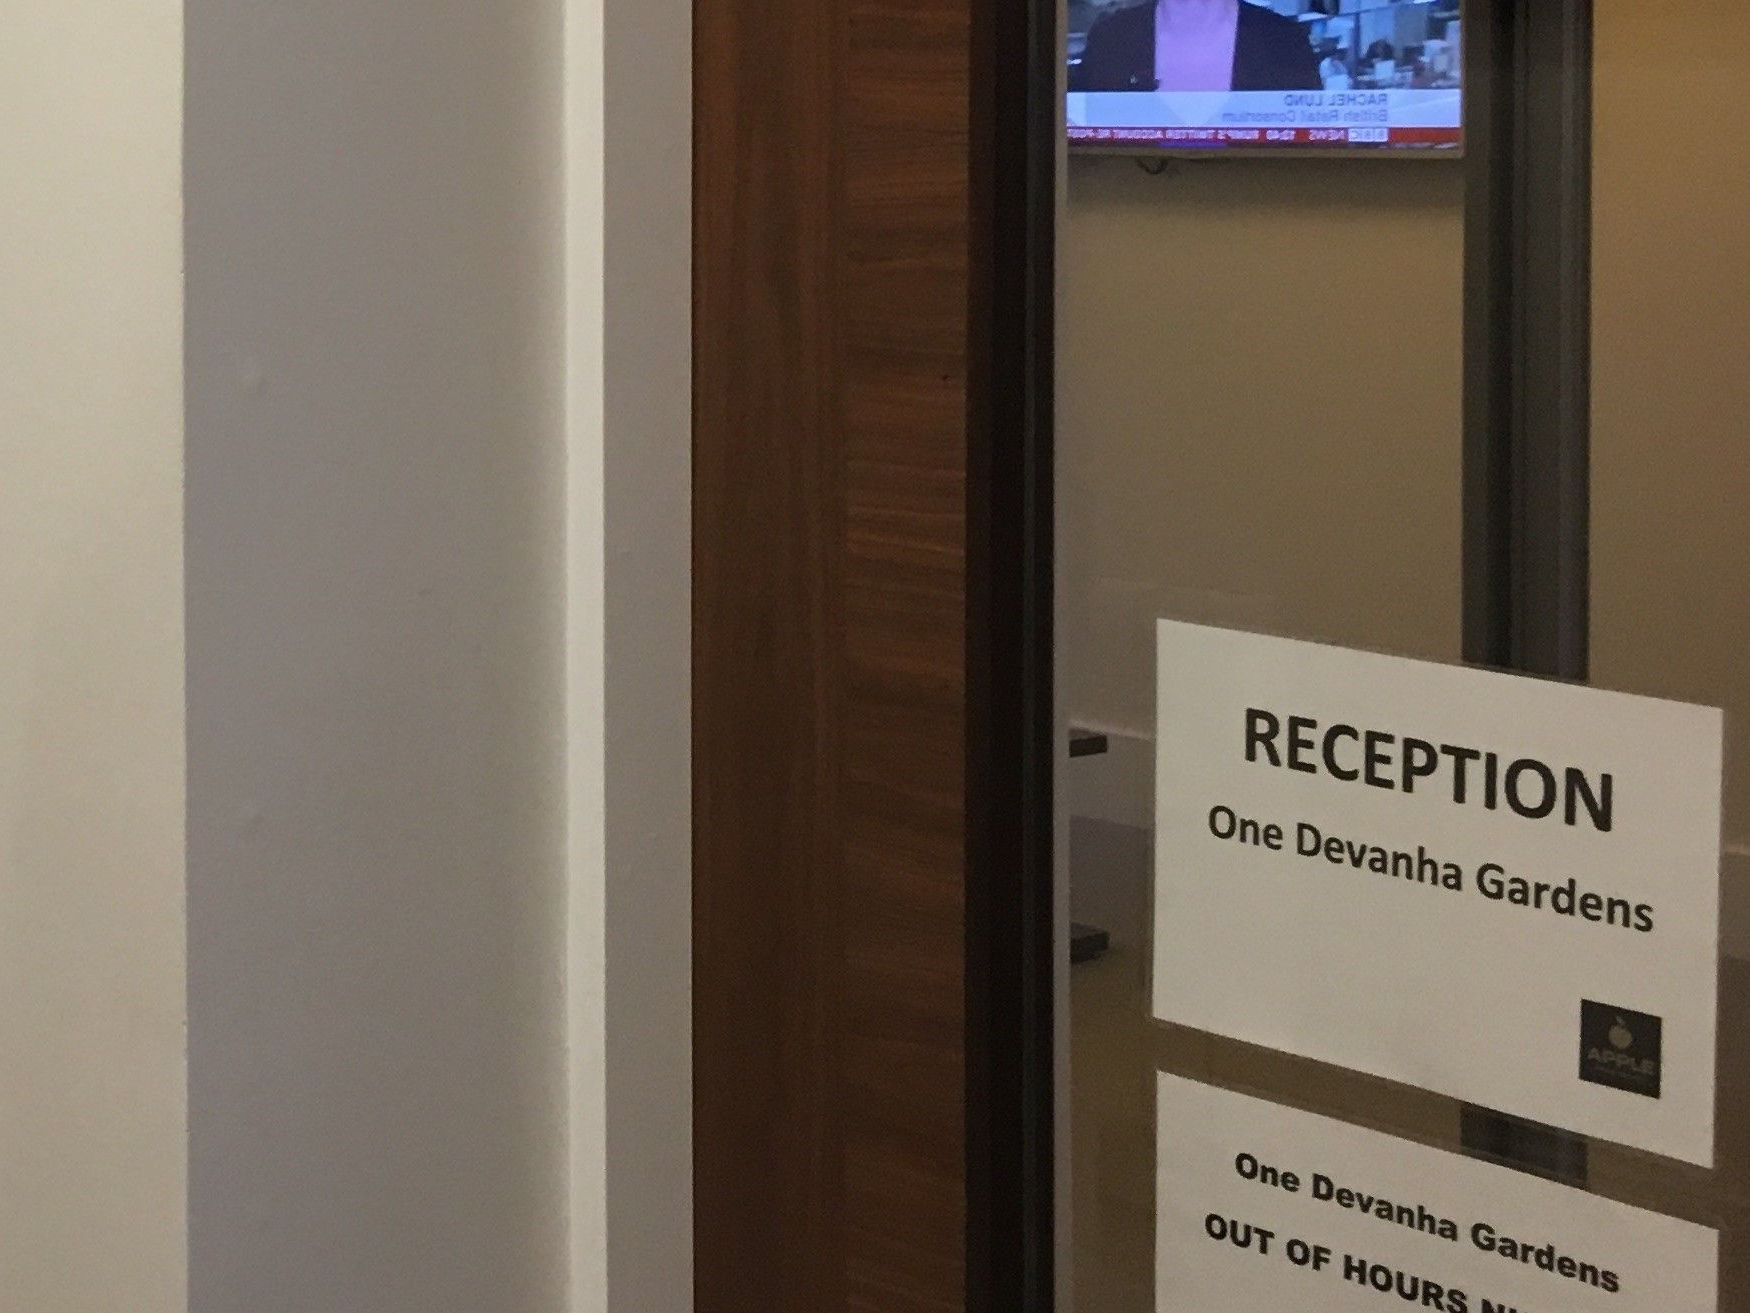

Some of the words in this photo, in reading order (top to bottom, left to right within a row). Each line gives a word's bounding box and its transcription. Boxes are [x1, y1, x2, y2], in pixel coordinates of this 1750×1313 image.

[1245, 707, 1613, 832] RECEPTION
[1209, 805, 1283, 850] One
[1297, 822, 1463, 892] Devanha
[1477, 862, 1654, 933] Gardens
[1587, 1046, 1656, 1075] APPLE
[1205, 1213, 1276, 1256] OUT
[1286, 1238, 1332, 1272] OF
[1343, 1253, 1469, 1313] HOURS
[1235, 1152, 1300, 1193] One
[1312, 1172, 1459, 1243] Devanha
[1470, 1222, 1620, 1294] Gardens
